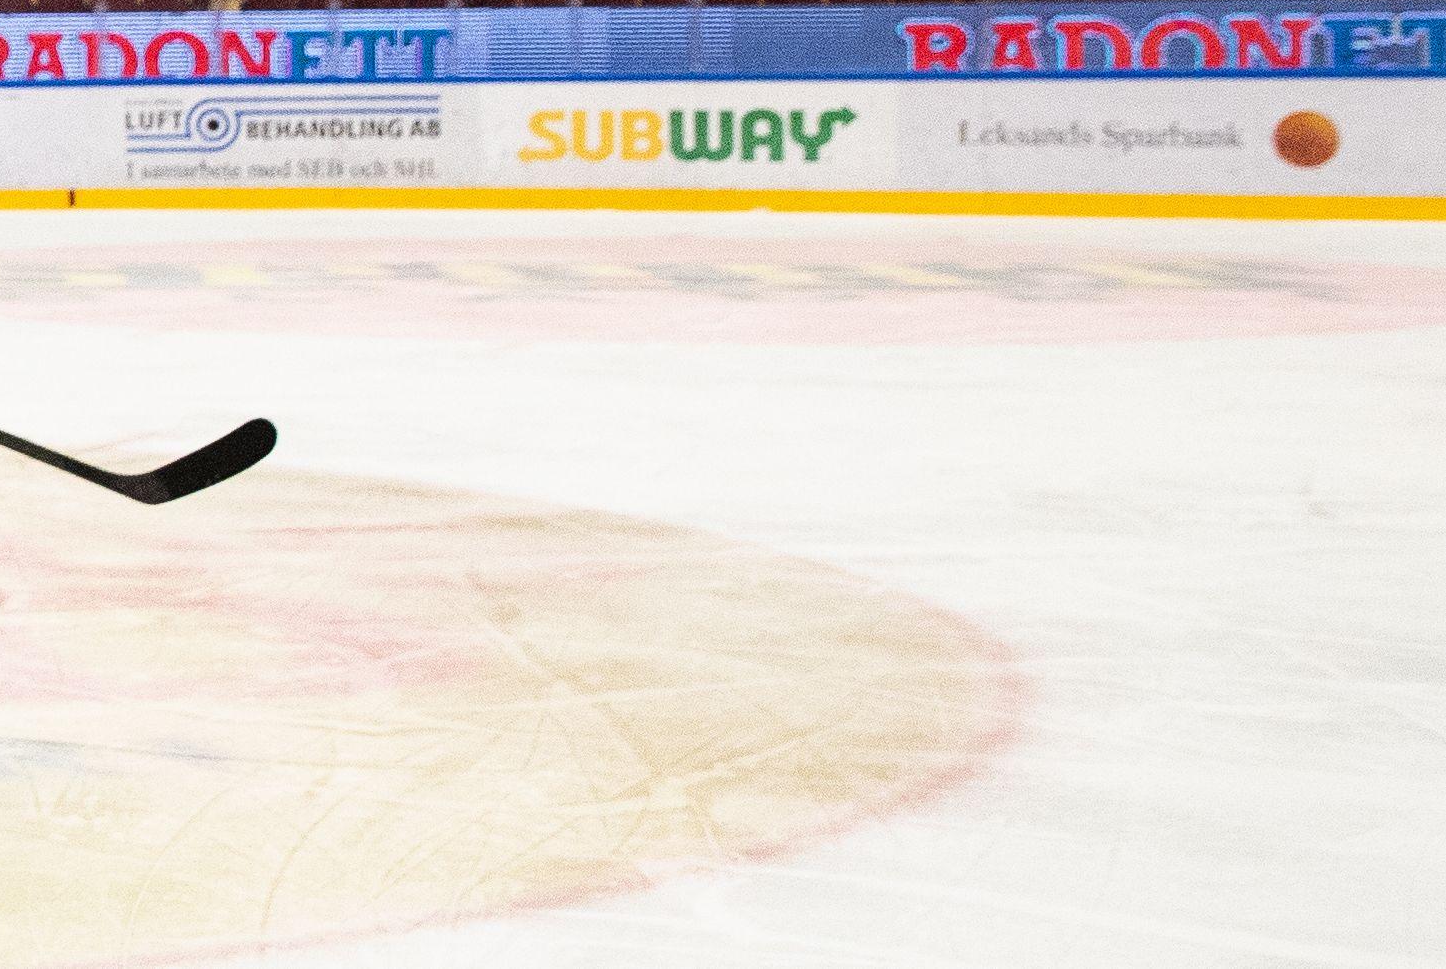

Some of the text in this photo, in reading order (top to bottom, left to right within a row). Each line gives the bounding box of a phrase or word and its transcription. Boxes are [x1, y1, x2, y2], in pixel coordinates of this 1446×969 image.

[125, 110, 183, 130] LUFT
[246, 118, 441, 139] BEHANDLING AB
[518, 107, 855, 162] SUBWAY
